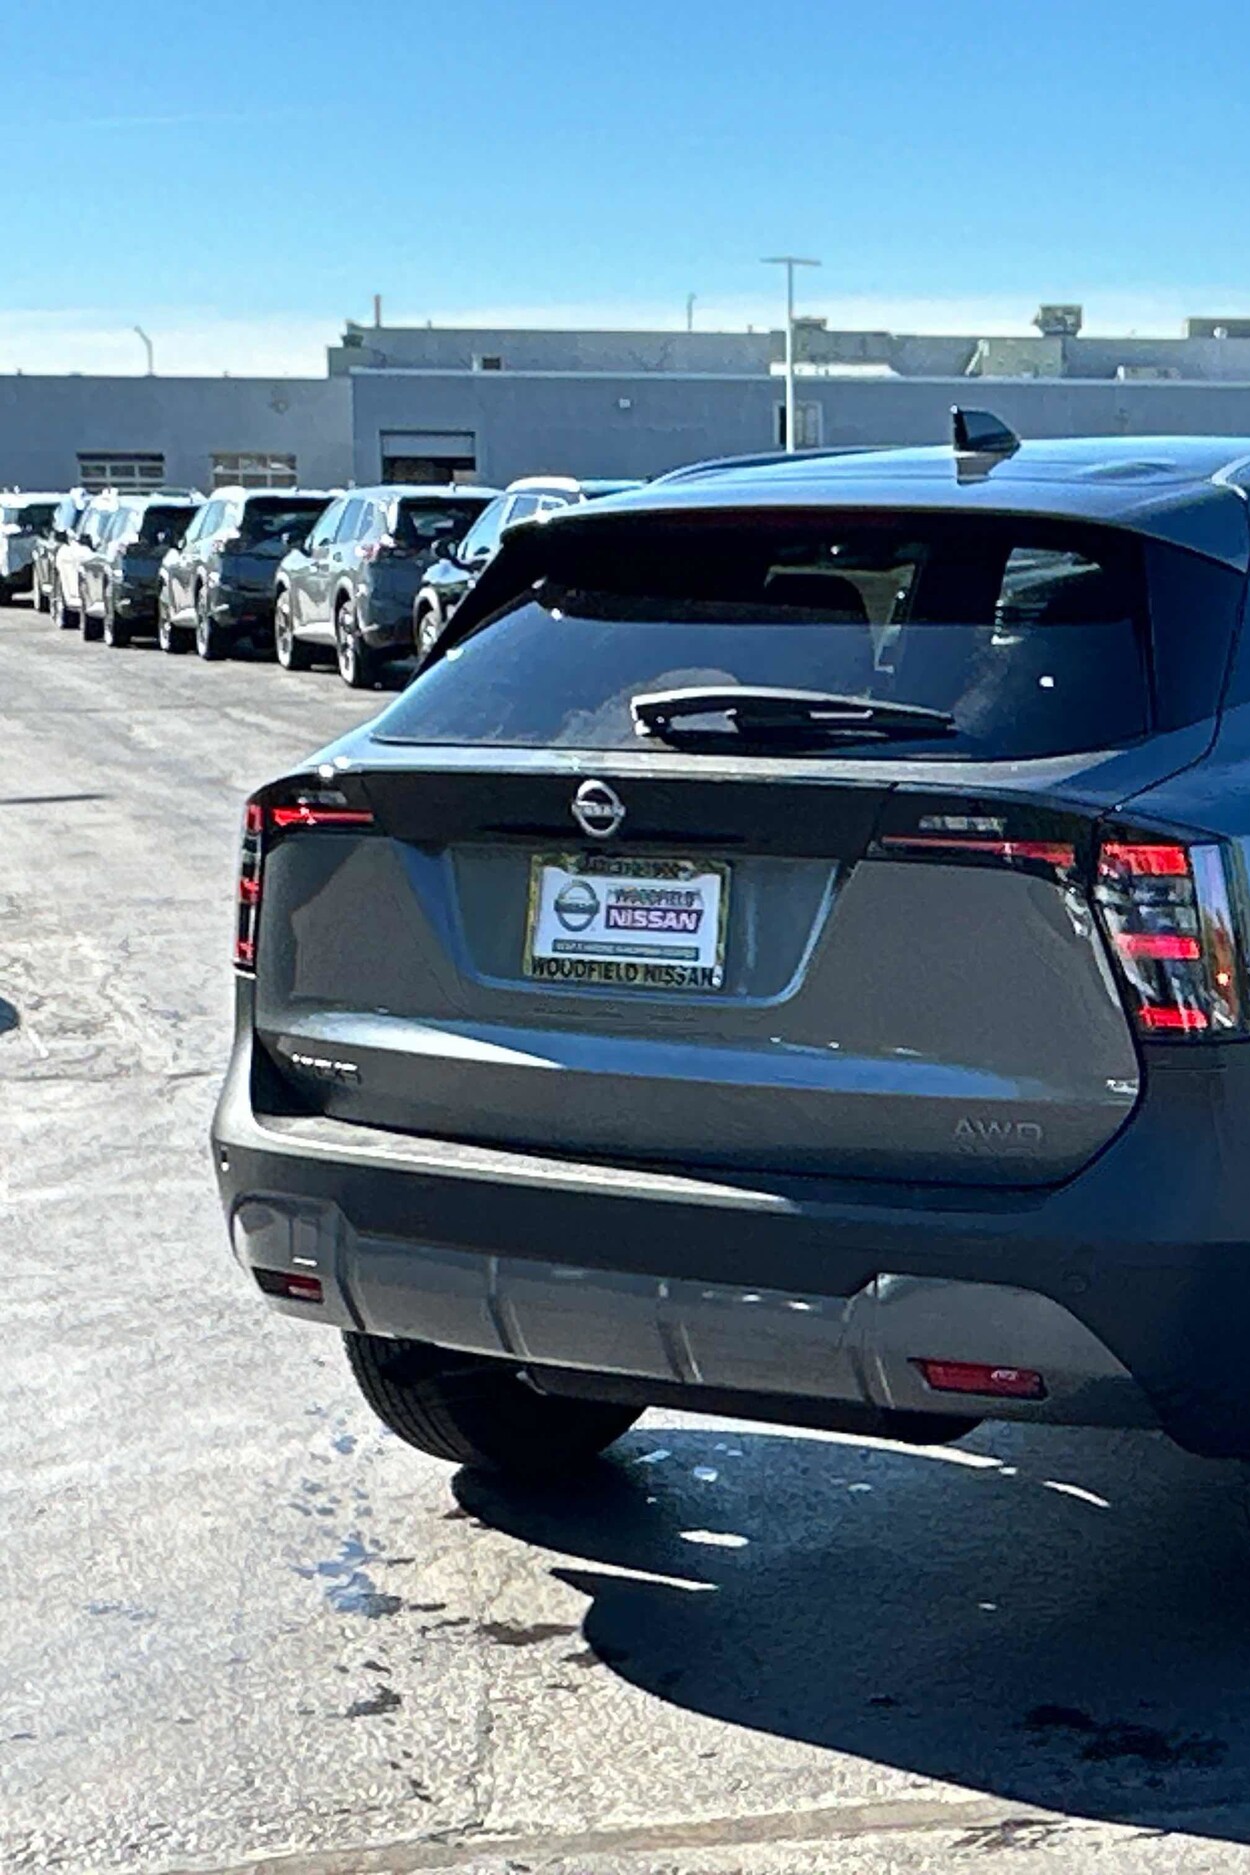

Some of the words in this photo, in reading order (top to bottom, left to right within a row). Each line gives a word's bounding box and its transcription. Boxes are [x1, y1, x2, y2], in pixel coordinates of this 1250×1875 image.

[608, 909, 698, 931] NISSAN
[532, 957, 639, 981] WOODFIELD
[643, 965, 714, 987] NISSAN
